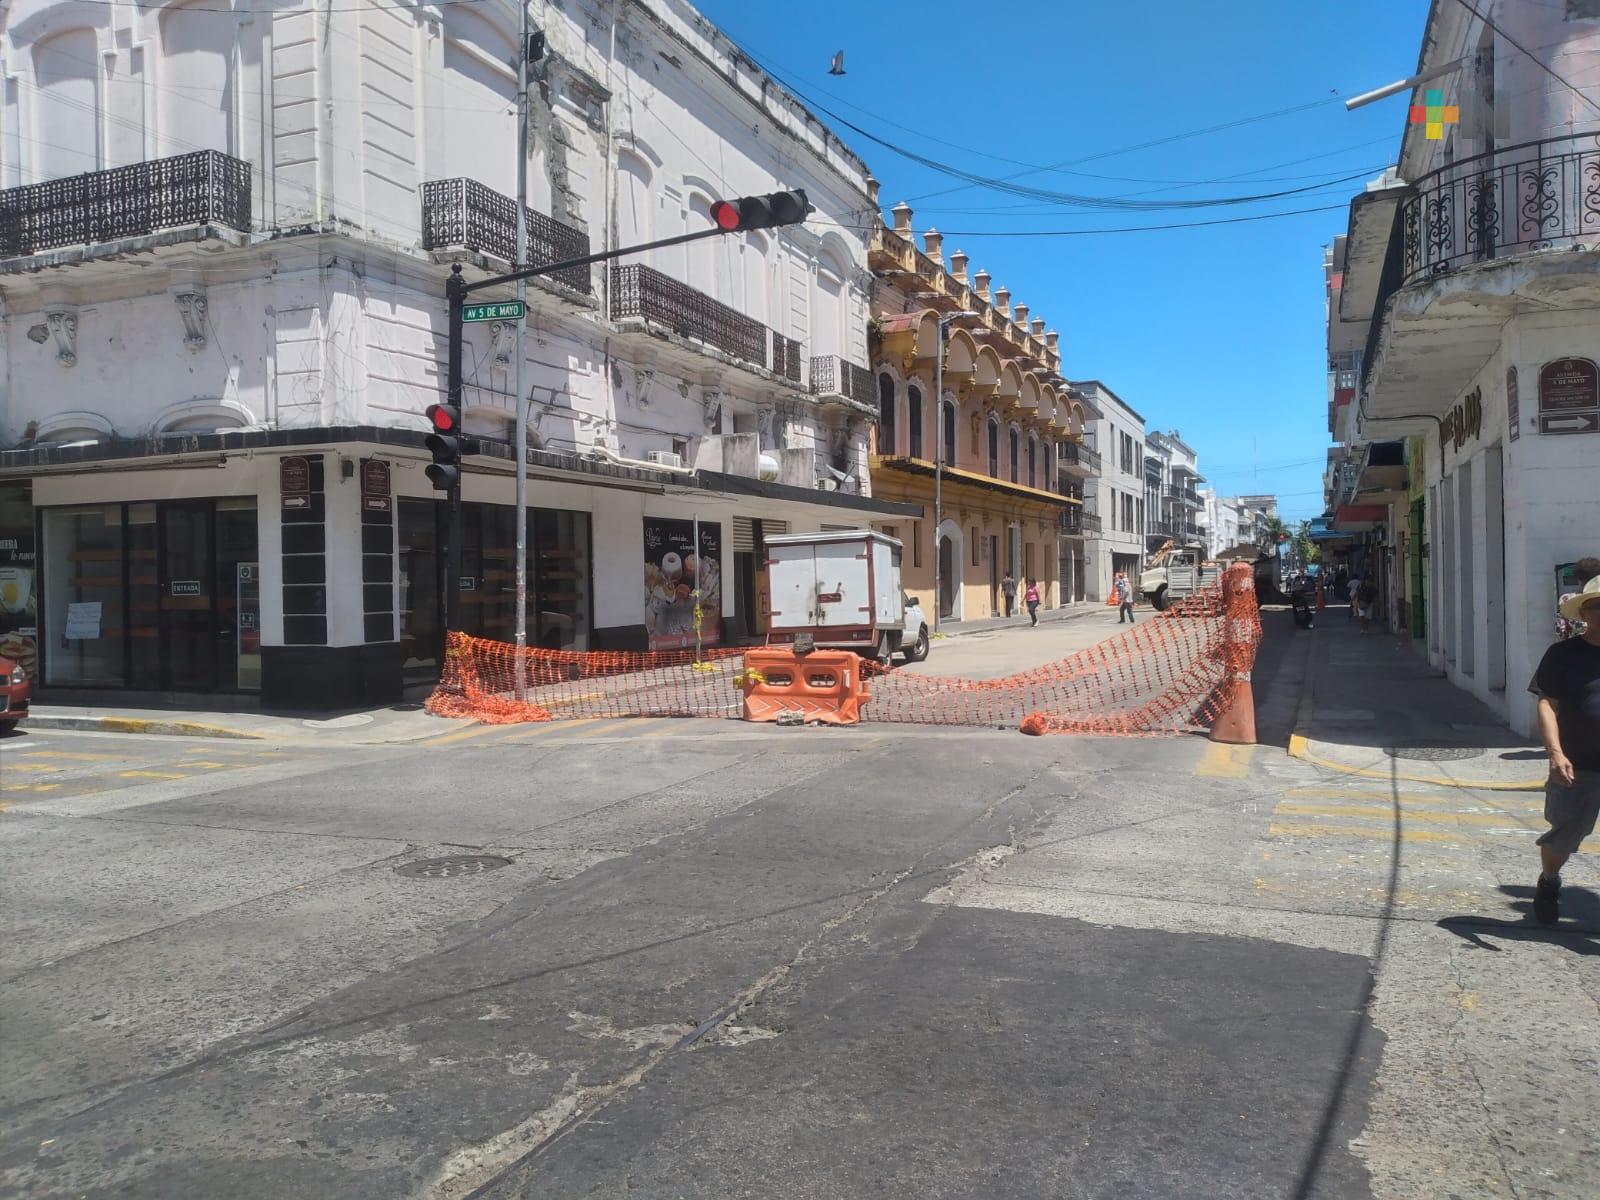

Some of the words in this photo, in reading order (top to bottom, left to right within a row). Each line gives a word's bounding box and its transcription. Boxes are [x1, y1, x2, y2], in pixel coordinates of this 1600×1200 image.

[468, 310, 476, 318] AV
[479, 308, 484, 317] 5
[487, 306, 496, 316] DE
[500, 305, 518, 316] MAYO
